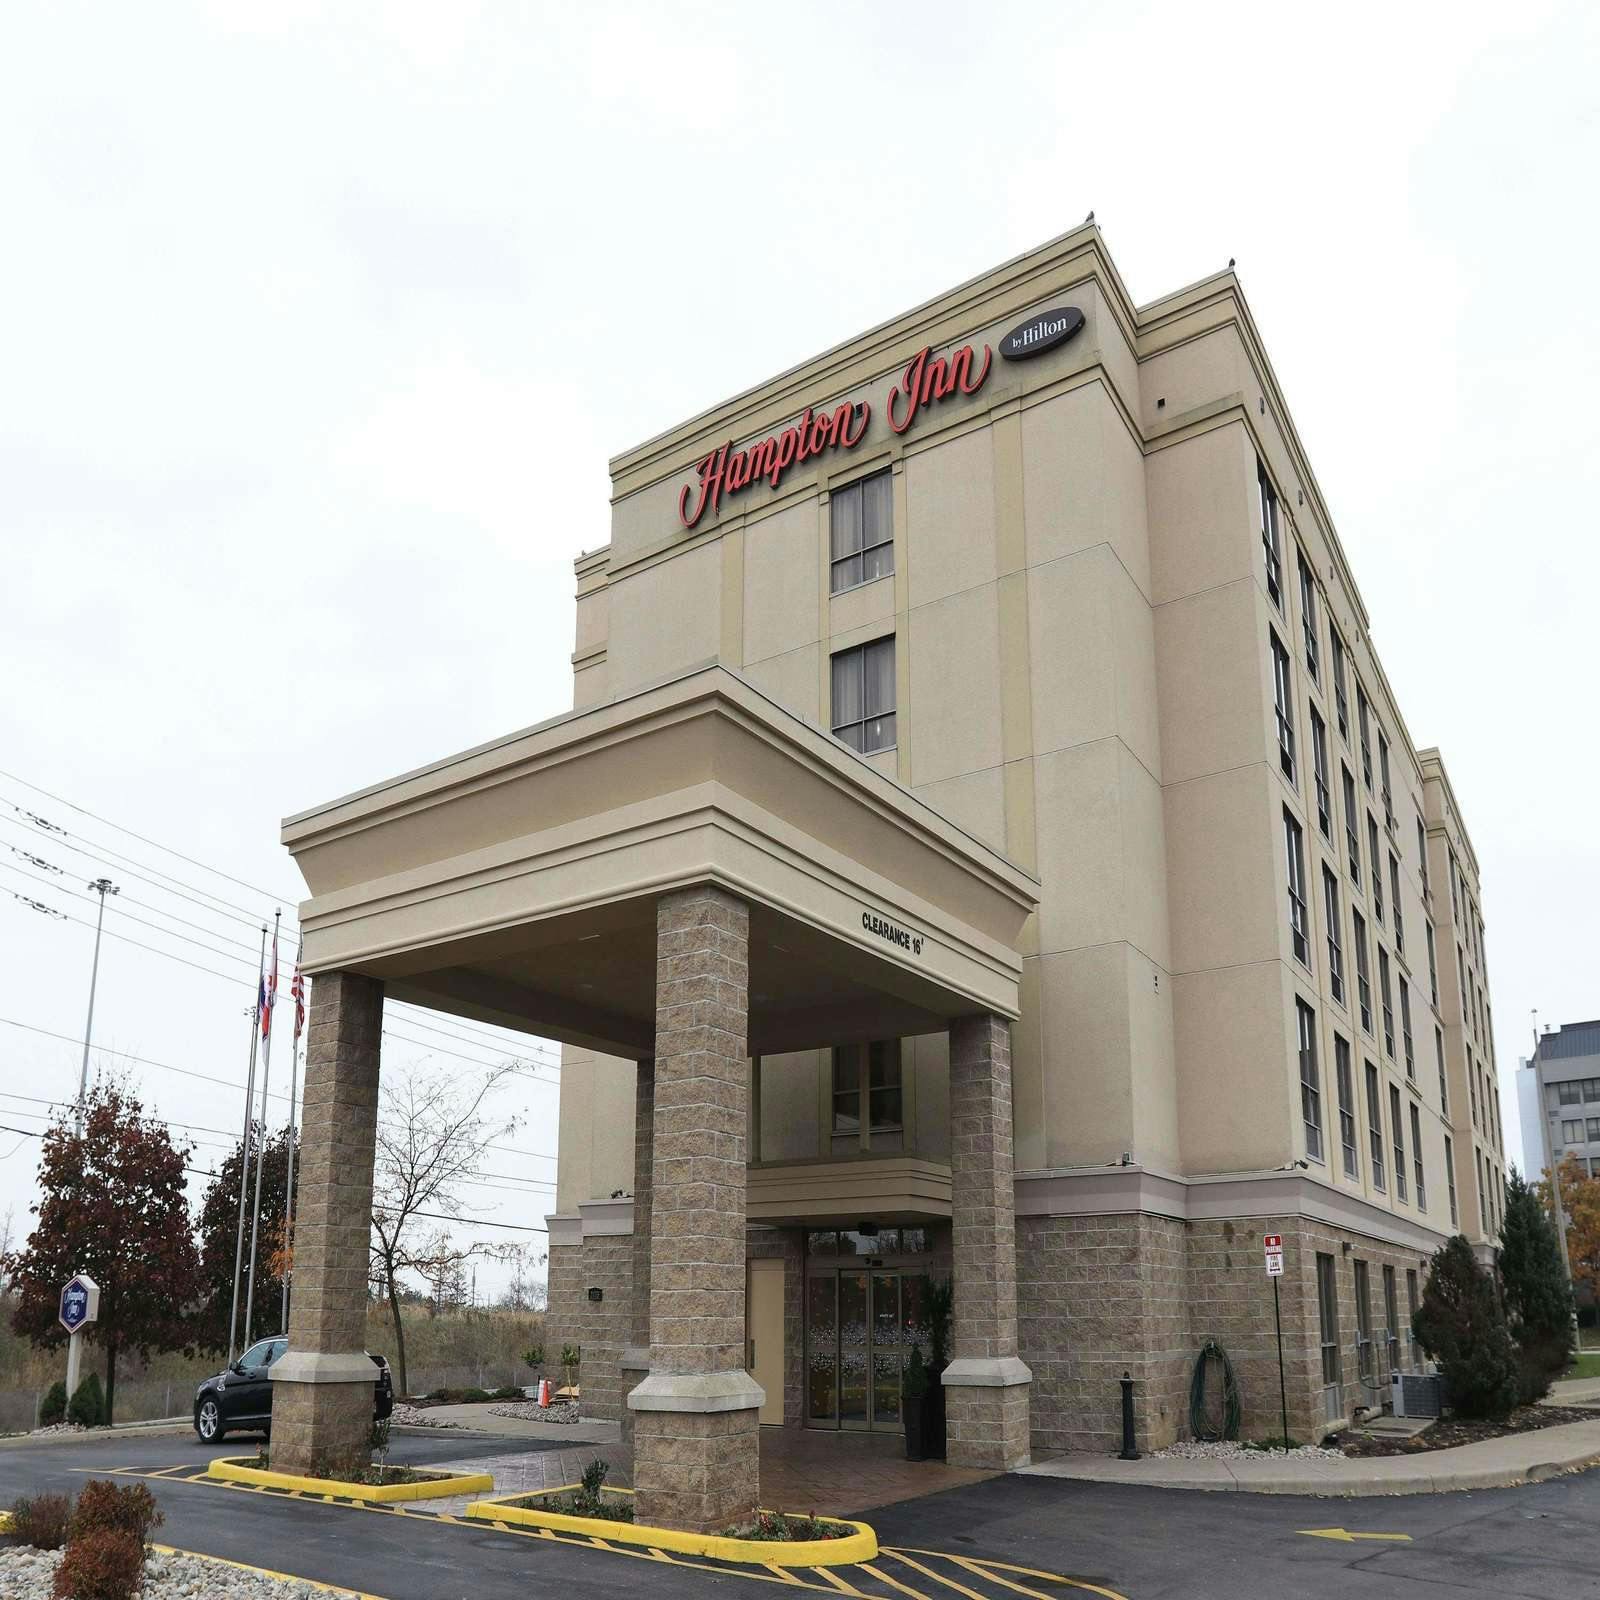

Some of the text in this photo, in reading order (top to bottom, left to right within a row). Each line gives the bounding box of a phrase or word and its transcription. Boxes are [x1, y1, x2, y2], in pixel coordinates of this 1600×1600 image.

[1012, 318, 1067, 349] by Hilton
[679, 343, 992, 528] Hampton Inn
[862, 912, 910, 950] CLEARANCE
